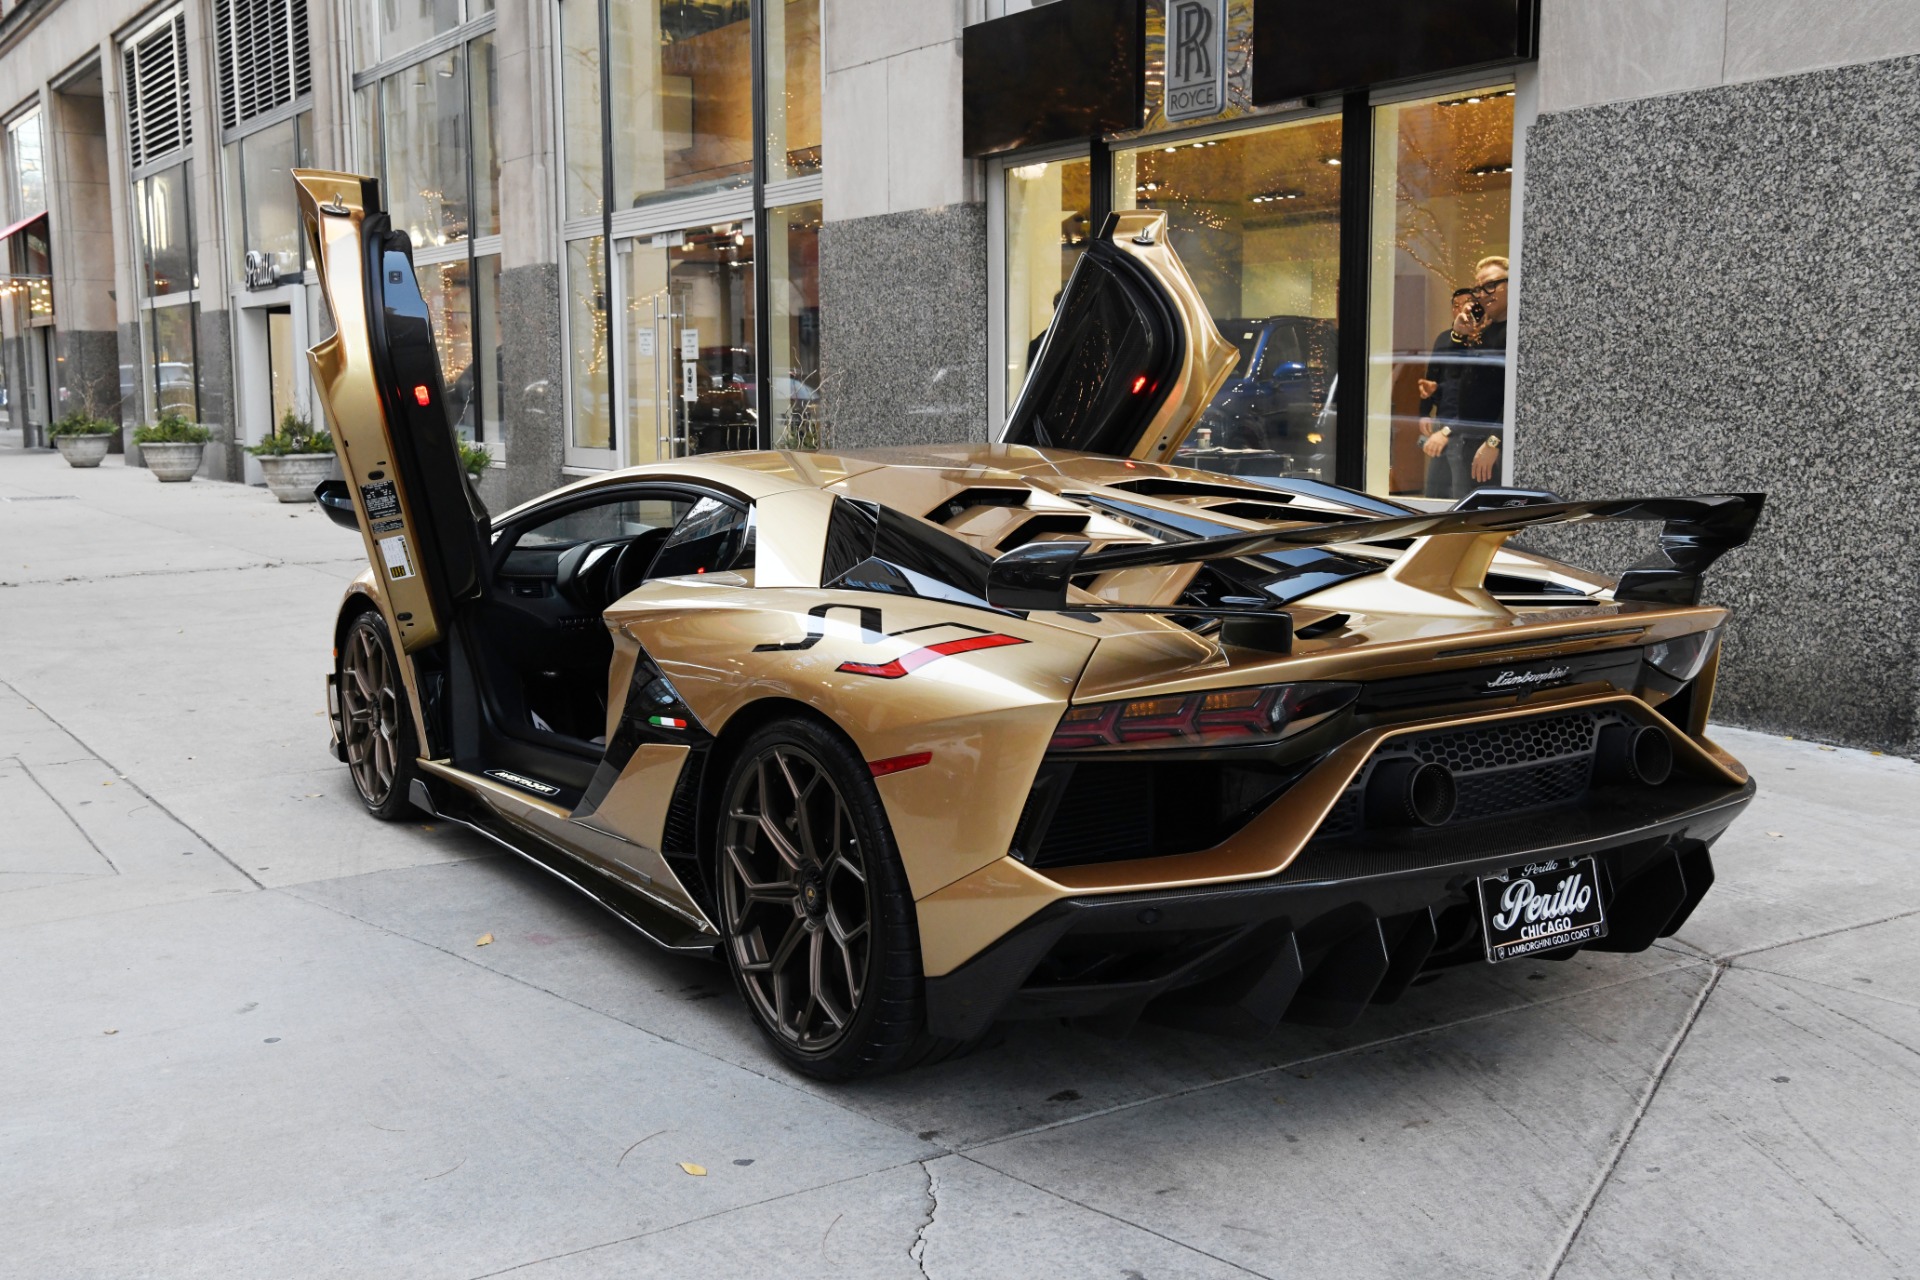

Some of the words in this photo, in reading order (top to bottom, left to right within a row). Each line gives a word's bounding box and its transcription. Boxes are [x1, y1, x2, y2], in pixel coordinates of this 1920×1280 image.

[1170, 87, 1214, 110] ROYCE
[1487, 665, 1570, 688] Lamborghini
[1521, 860, 1559, 877] Perillo
[1493, 874, 1591, 931] Perillo
[1520, 917, 1571, 940] CHICAGO
[1508, 939, 1551, 956] LAMBORGHINI
[1553, 932, 1570, 946] GOLD
[1571, 928, 1591, 941] COAST
